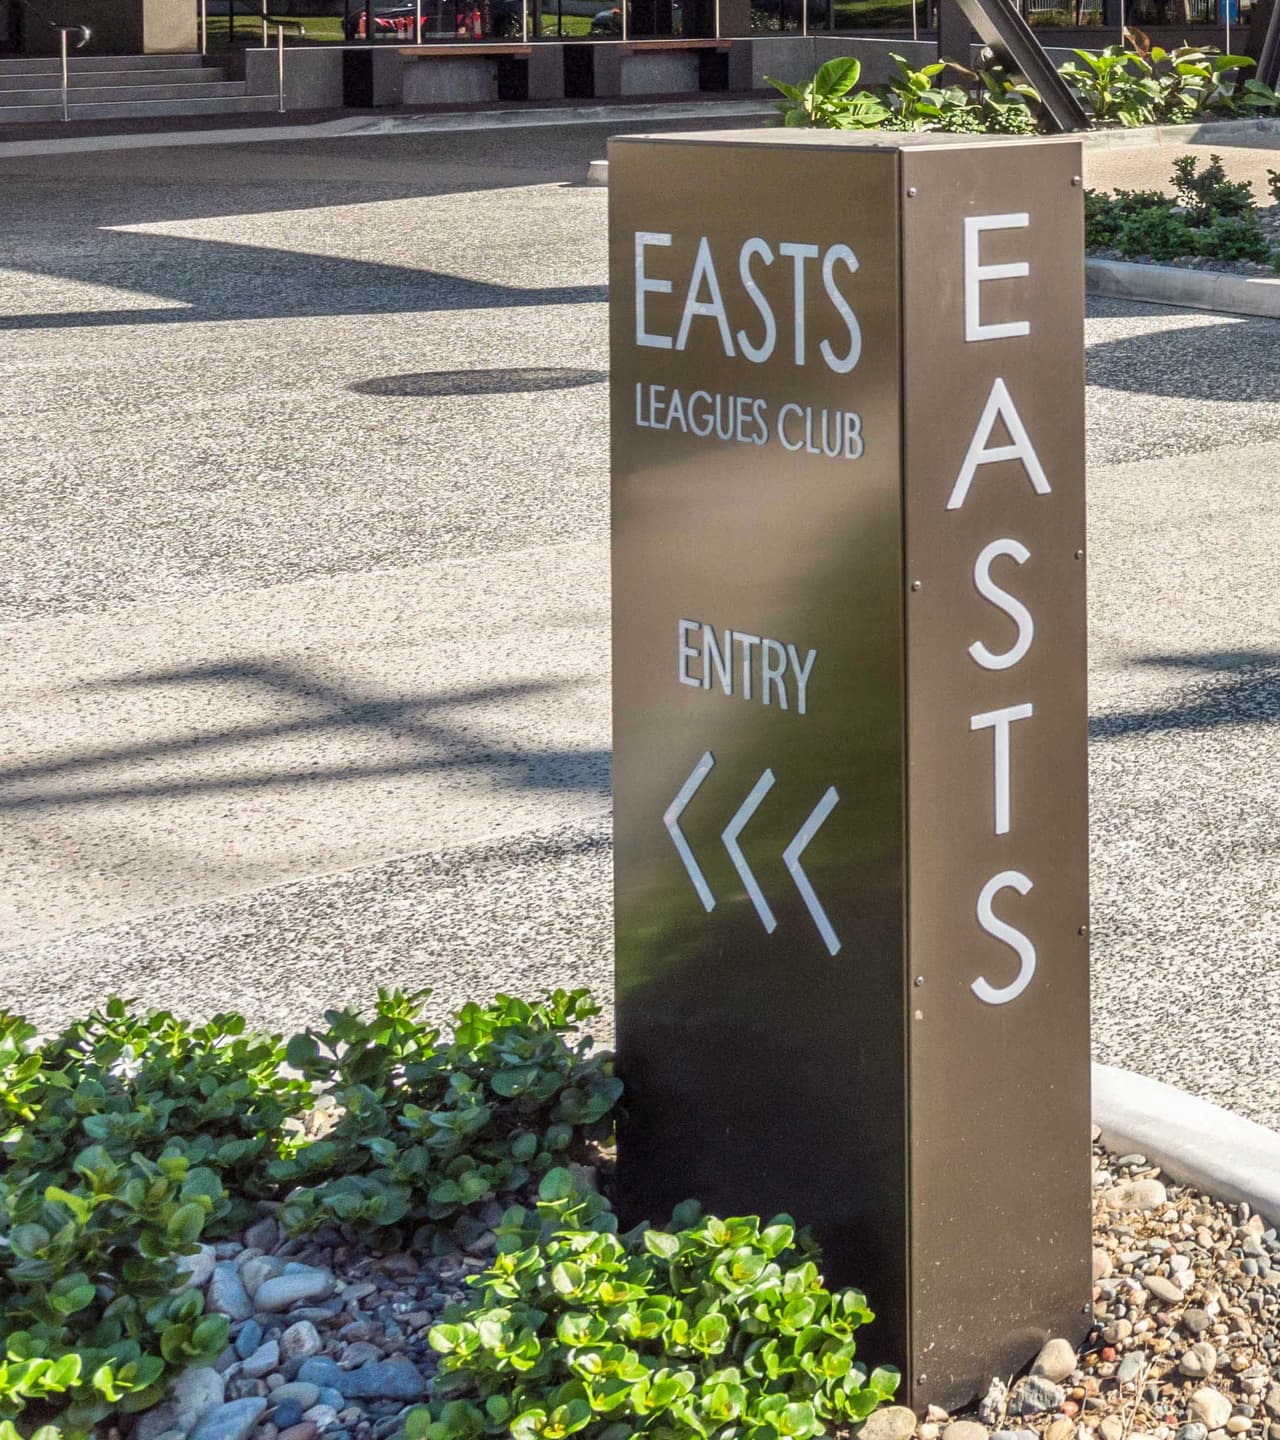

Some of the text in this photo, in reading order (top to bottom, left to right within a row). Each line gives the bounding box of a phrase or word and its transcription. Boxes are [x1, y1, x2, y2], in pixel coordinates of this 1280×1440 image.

[634, 231, 863, 375] EASTS
[635, 381, 865, 460] LEAGUES CLUB
[677, 617, 818, 717] ENTRY
[945, 211, 1053, 1007] EASTS
